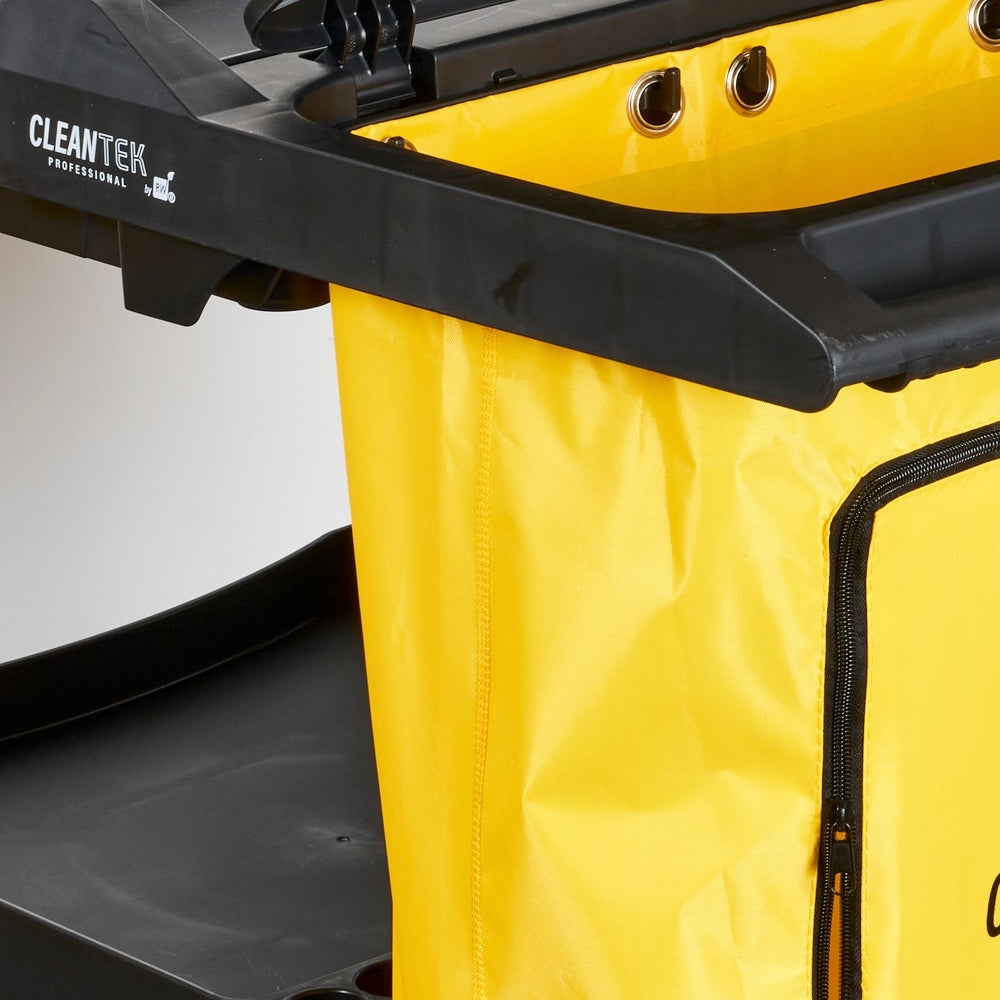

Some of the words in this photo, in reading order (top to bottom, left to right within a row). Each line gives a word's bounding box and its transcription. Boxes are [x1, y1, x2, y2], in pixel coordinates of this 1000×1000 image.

[29, 113, 147, 177] CLEANTEK
[48, 157, 127, 188] PROFESSIONAL
[144, 184, 153, 197] by
